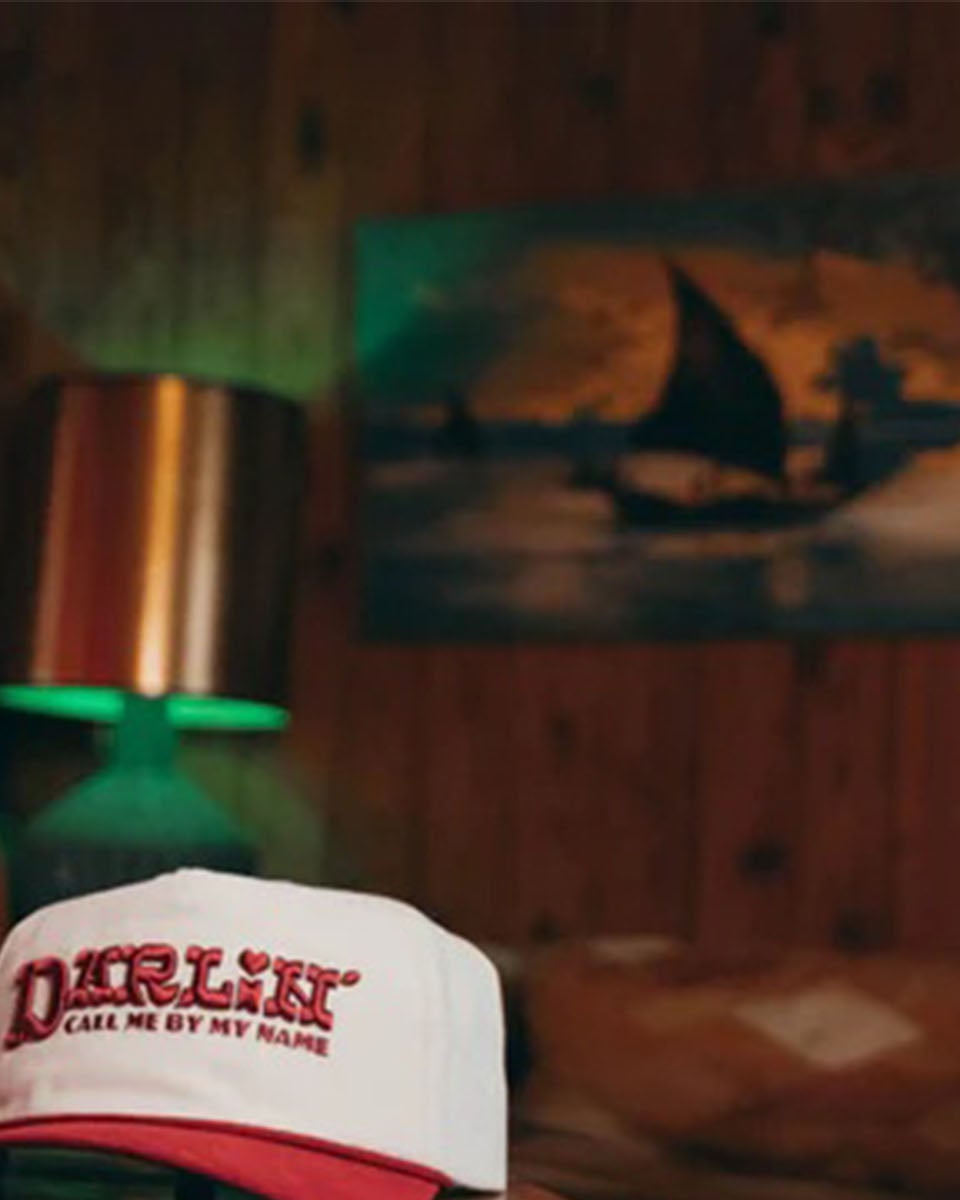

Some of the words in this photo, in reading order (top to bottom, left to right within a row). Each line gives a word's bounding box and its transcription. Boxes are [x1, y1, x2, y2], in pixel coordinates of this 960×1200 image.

[64, 1012, 118, 1035] CALL
[124, 1012, 158, 1032] ME
[166, 1012, 203, 1033] BY
[209, 1019, 252, 1038] MY
[256, 1025, 330, 1057] NAME
